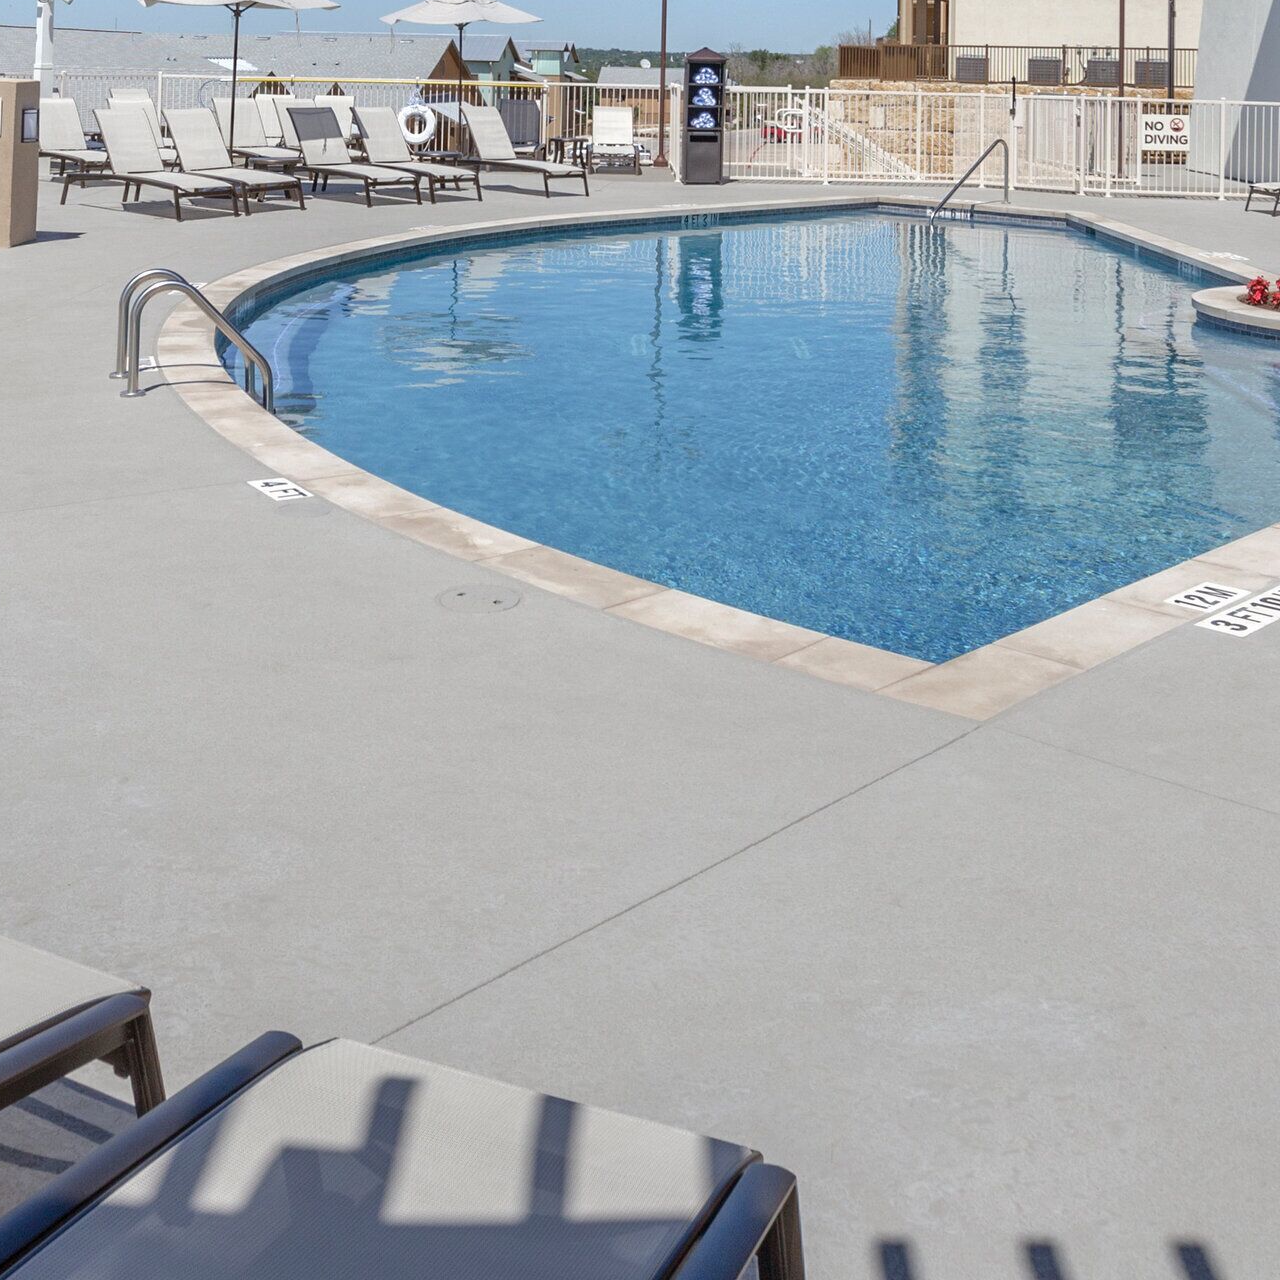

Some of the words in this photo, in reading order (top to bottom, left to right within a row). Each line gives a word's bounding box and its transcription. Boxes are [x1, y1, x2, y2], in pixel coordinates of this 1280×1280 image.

[1144, 121, 1164, 131] NO
[1144, 134, 1188, 145] DIVING
[269, 487, 308, 499] FT
[1226, 606, 1274, 623] FT
[1210, 619, 1248, 632] 3
